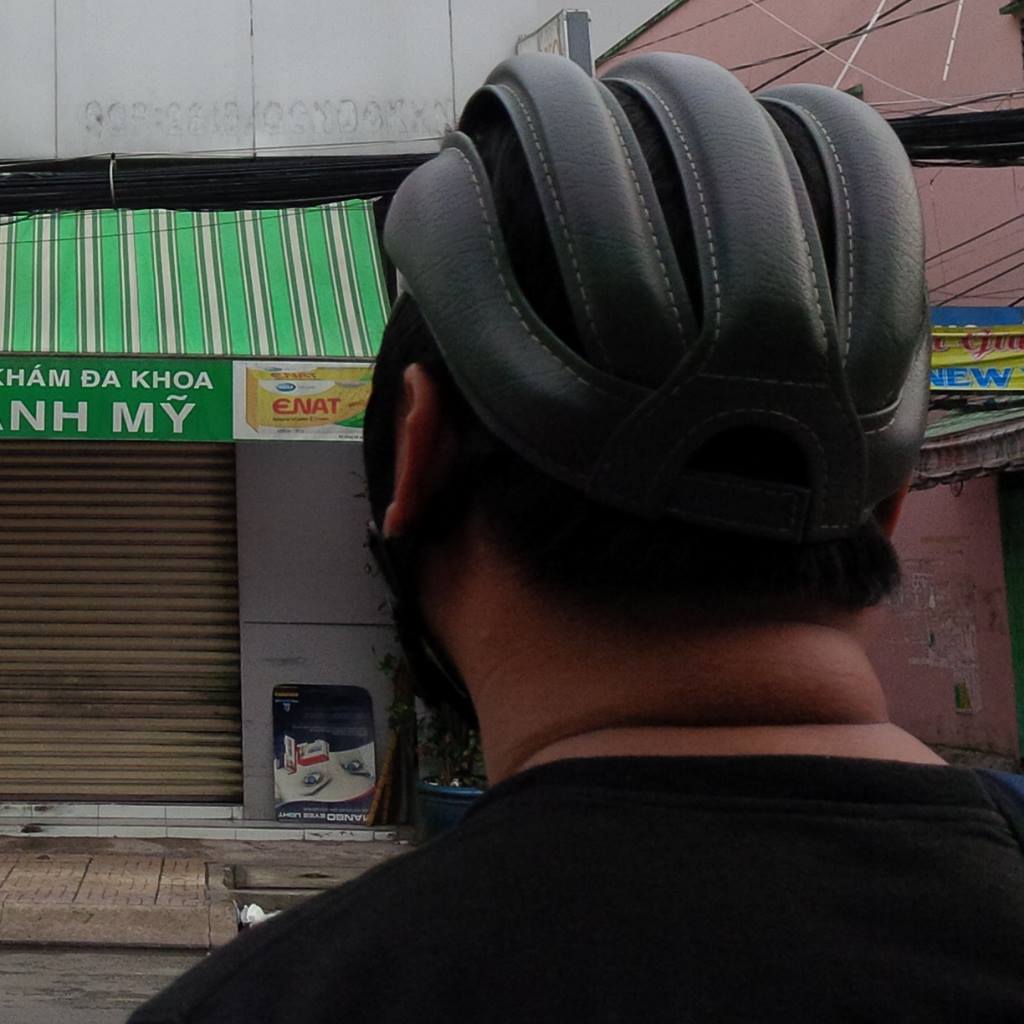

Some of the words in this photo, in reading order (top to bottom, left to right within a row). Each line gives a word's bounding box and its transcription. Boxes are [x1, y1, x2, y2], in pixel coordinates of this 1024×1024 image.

[81, 369, 121, 388] ĐA
[131, 370, 214, 390] KHOA
[931, 367, 1012, 388] NEW
[112, 394, 196, 434] MỸ
[272, 397, 341, 415] ENAT
